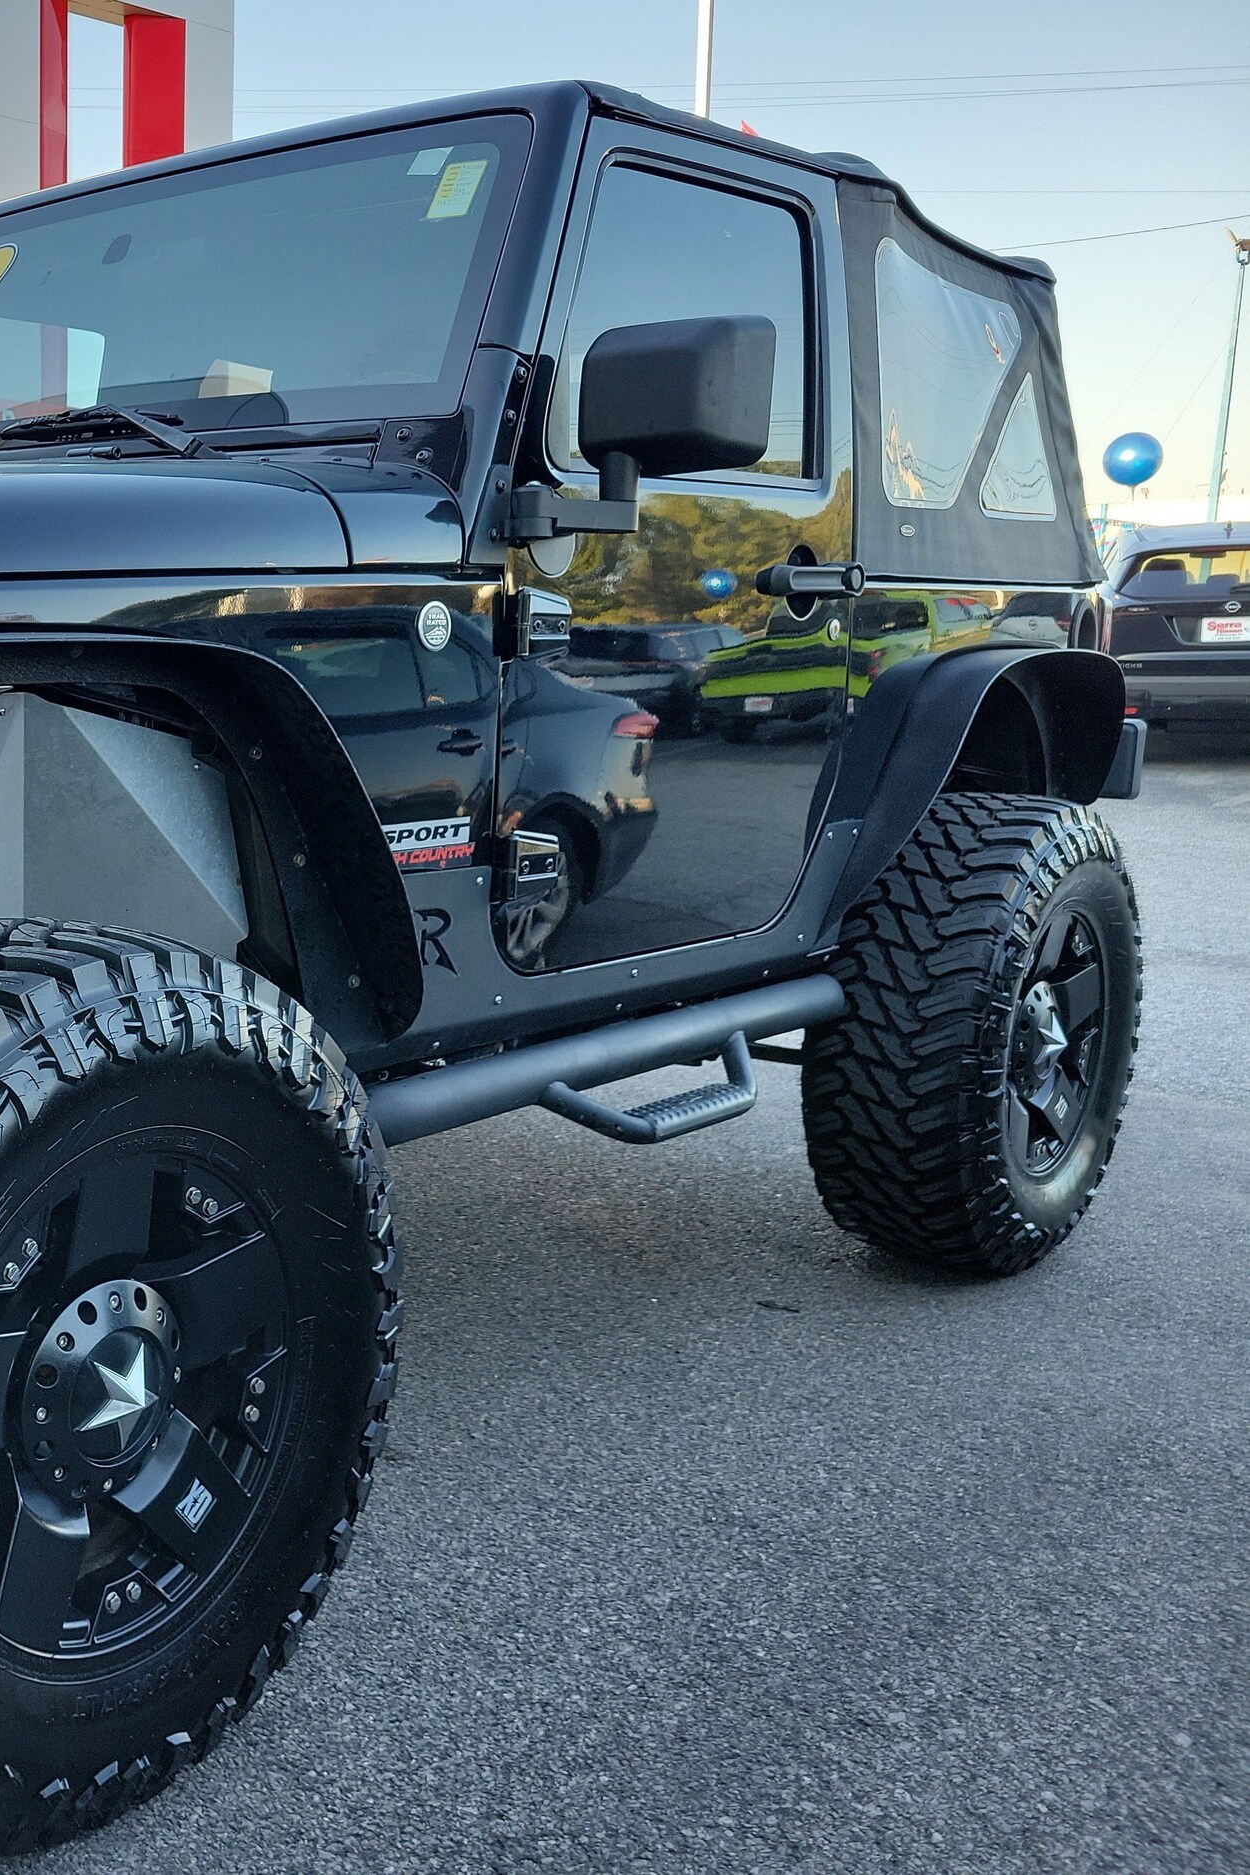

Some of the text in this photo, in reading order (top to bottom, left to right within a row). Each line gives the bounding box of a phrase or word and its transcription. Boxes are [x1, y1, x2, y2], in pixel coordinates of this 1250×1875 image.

[1207, 621, 1243, 631] Serra
[384, 822, 470, 845] SPORT
[410, 842, 476, 864] COUNTRY
